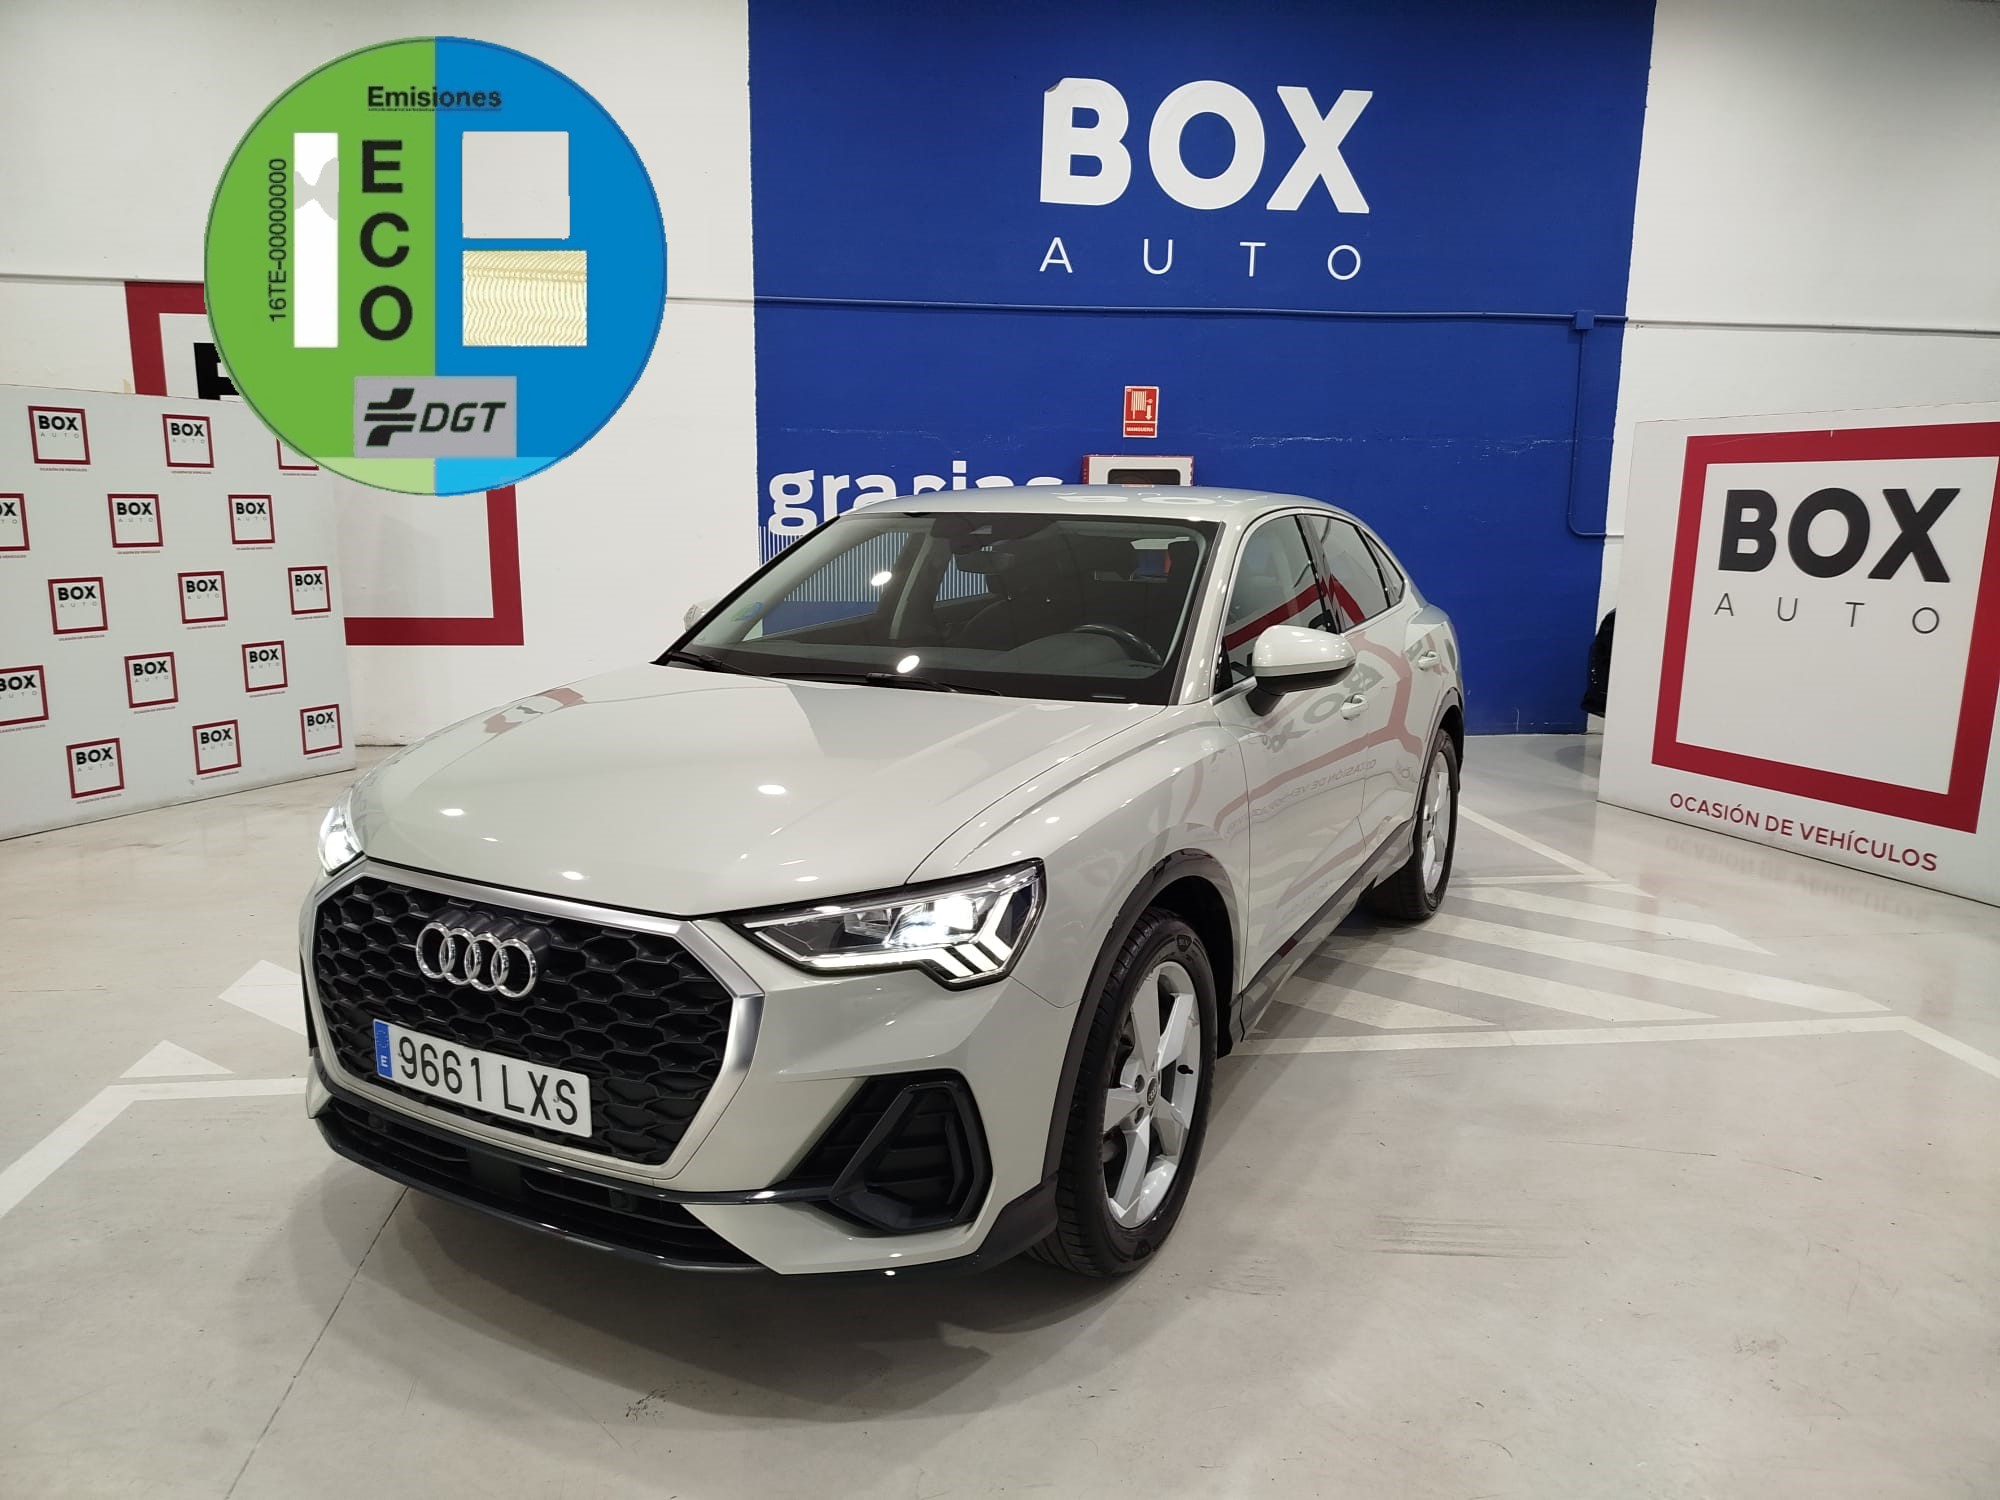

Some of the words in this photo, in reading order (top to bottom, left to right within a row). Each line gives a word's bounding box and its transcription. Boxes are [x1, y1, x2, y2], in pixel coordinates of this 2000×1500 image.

[1040, 77, 1373, 214] BOX
[1039, 236, 1362, 281] AUTO
[38, 415, 79, 431] BOX
[170, 422, 205, 437] BOX
[116, 502, 153, 515] BOX
[235, 502, 267, 515] BOX
[1718, 487, 1962, 583] BOX
[186, 579, 219, 593] BOX
[294, 573, 323, 586] BOX
[57, 585, 97, 601] BOX
[1714, 592, 1940, 634] AUTO
[249, 648, 280, 663] BOX
[132, 660, 169, 676] BOX
[306, 711, 335, 727] BOX
[200, 727, 233, 745] BOX
[75, 747, 114, 765] BOX
[1670, 793, 1760, 828] OCASIÓN
[1765, 815, 1794, 836] DE
[1800, 823, 1938, 872] VEHÍCULOS
[380, 1055, 389, 1068] E
[398, 1036, 483, 1102] 9661
[502, 1064, 578, 1126] LXS
